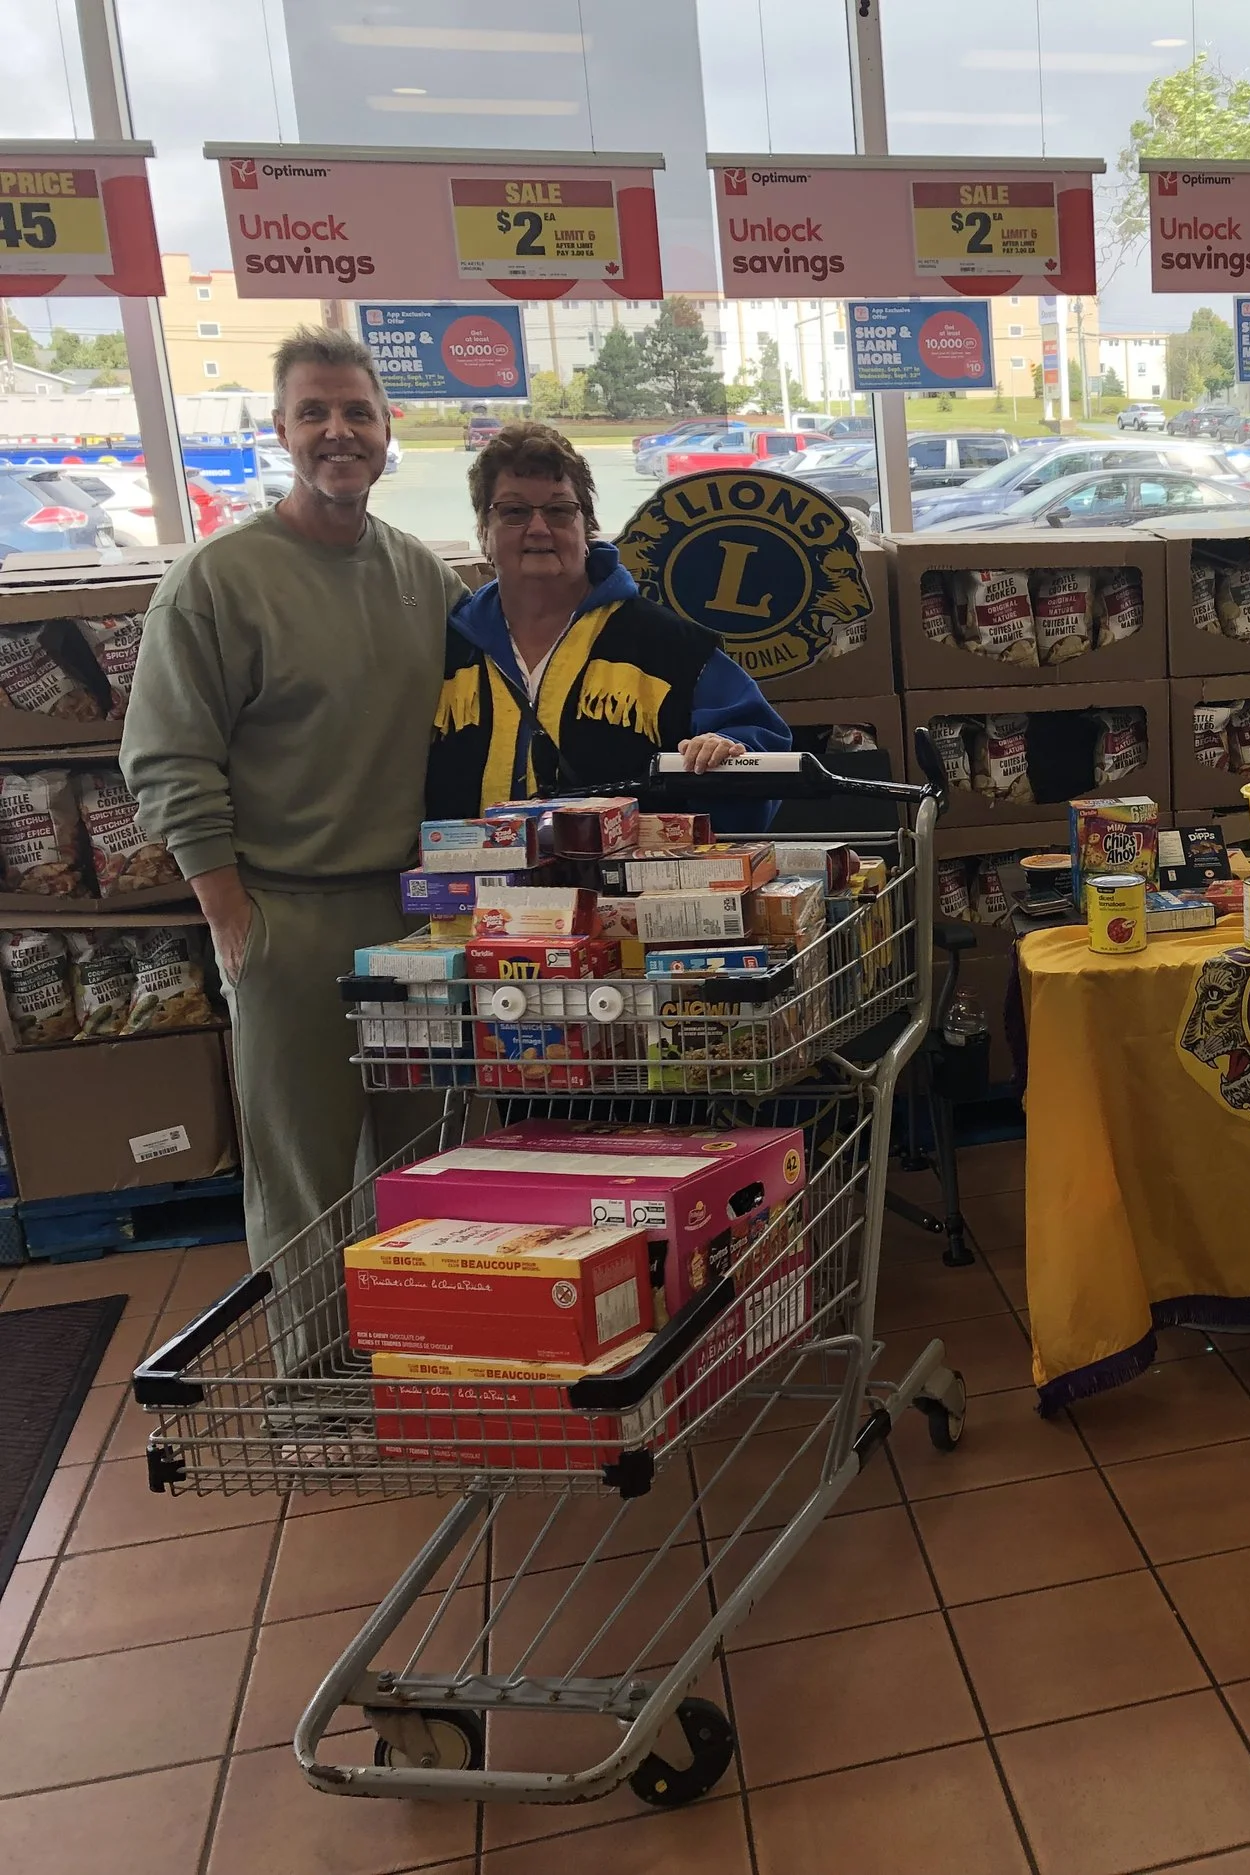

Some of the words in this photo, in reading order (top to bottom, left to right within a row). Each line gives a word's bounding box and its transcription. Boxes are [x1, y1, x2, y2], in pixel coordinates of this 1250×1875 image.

[1, 172, 76, 196] PRICE
[751, 172, 807, 184] Optimum
[1182, 174, 1231, 186] Optimum
[505, 183, 562, 204] SALE
[959, 185, 1010, 205] SALE
[239, 214, 349, 241] Unlock
[729, 216, 823, 243] Unlock
[1001, 229, 1027, 240] LIMIT
[1030, 229, 1038, 240] 6
[1160, 217, 1242, 241] Unlock
[555, 230, 584, 241] LIMIT
[588, 230, 596, 241] 6
[246, 247, 375, 283] savings
[732, 247, 845, 282] savings
[368, 331, 416, 344] SHOP
[419, 331, 434, 344] &
[855, 326, 896, 339] SHOP
[899, 325, 912, 338] &
[449, 345, 492, 357] 10,000
[856, 340, 897, 352] EARN
[925, 339, 962, 350] 10,000
[371, 345, 418, 359] EARN
[857, 353, 902, 365] MORE
[374, 360, 423, 372] MORE
[674, 480, 834, 540] LIONS
[704, 540, 772, 618] L
[986, 577, 1014, 594] KETTLE
[985, 586, 1017, 603] COOKED
[1050, 582, 1079, 594] COOKED
[987, 600, 1018, 615] ORIGINAL
[1049, 605, 1074, 615] NATURE
[992, 611, 1018, 624] NATURE
[1042, 618, 1064, 628] CUITES
[989, 622, 1012, 637] CUITES
[1045, 625, 1076, 637] MARMITE
[992, 630, 1024, 645] MARMITE
[106, 651, 128, 660] SPICY
[26, 684, 61, 711] MARMITE
[735, 758, 760, 766] MORE
[1000, 757, 1021, 769] CUITES
[90, 810, 113, 822] SPICY
[1130, 806, 1139, 824] 6
[93, 818, 131, 834] KETCHUP
[1106, 823, 1127, 832] MINI
[103, 829, 131, 844] CUITES
[108, 833, 148, 853] MARMITE
[1103, 832, 1136, 852] Chips
[34, 840, 44, 851] LA
[8, 852, 42, 866] MARMITE
[498, 959, 541, 980] RITZ
[140, 970, 168, 985] CUITES
[145, 975, 182, 993] MARMITE
[22, 996, 61, 1013] MARMITE
[786, 1156, 798, 1171] 42
[393, 1256, 412, 1266] BIG
[709, 1246, 729, 1265] Doritos
[461, 1258, 522, 1270] BEAUCOUP
[420, 1363, 439, 1374] BIG
[486, 1368, 546, 1381] BEAUCOUP
